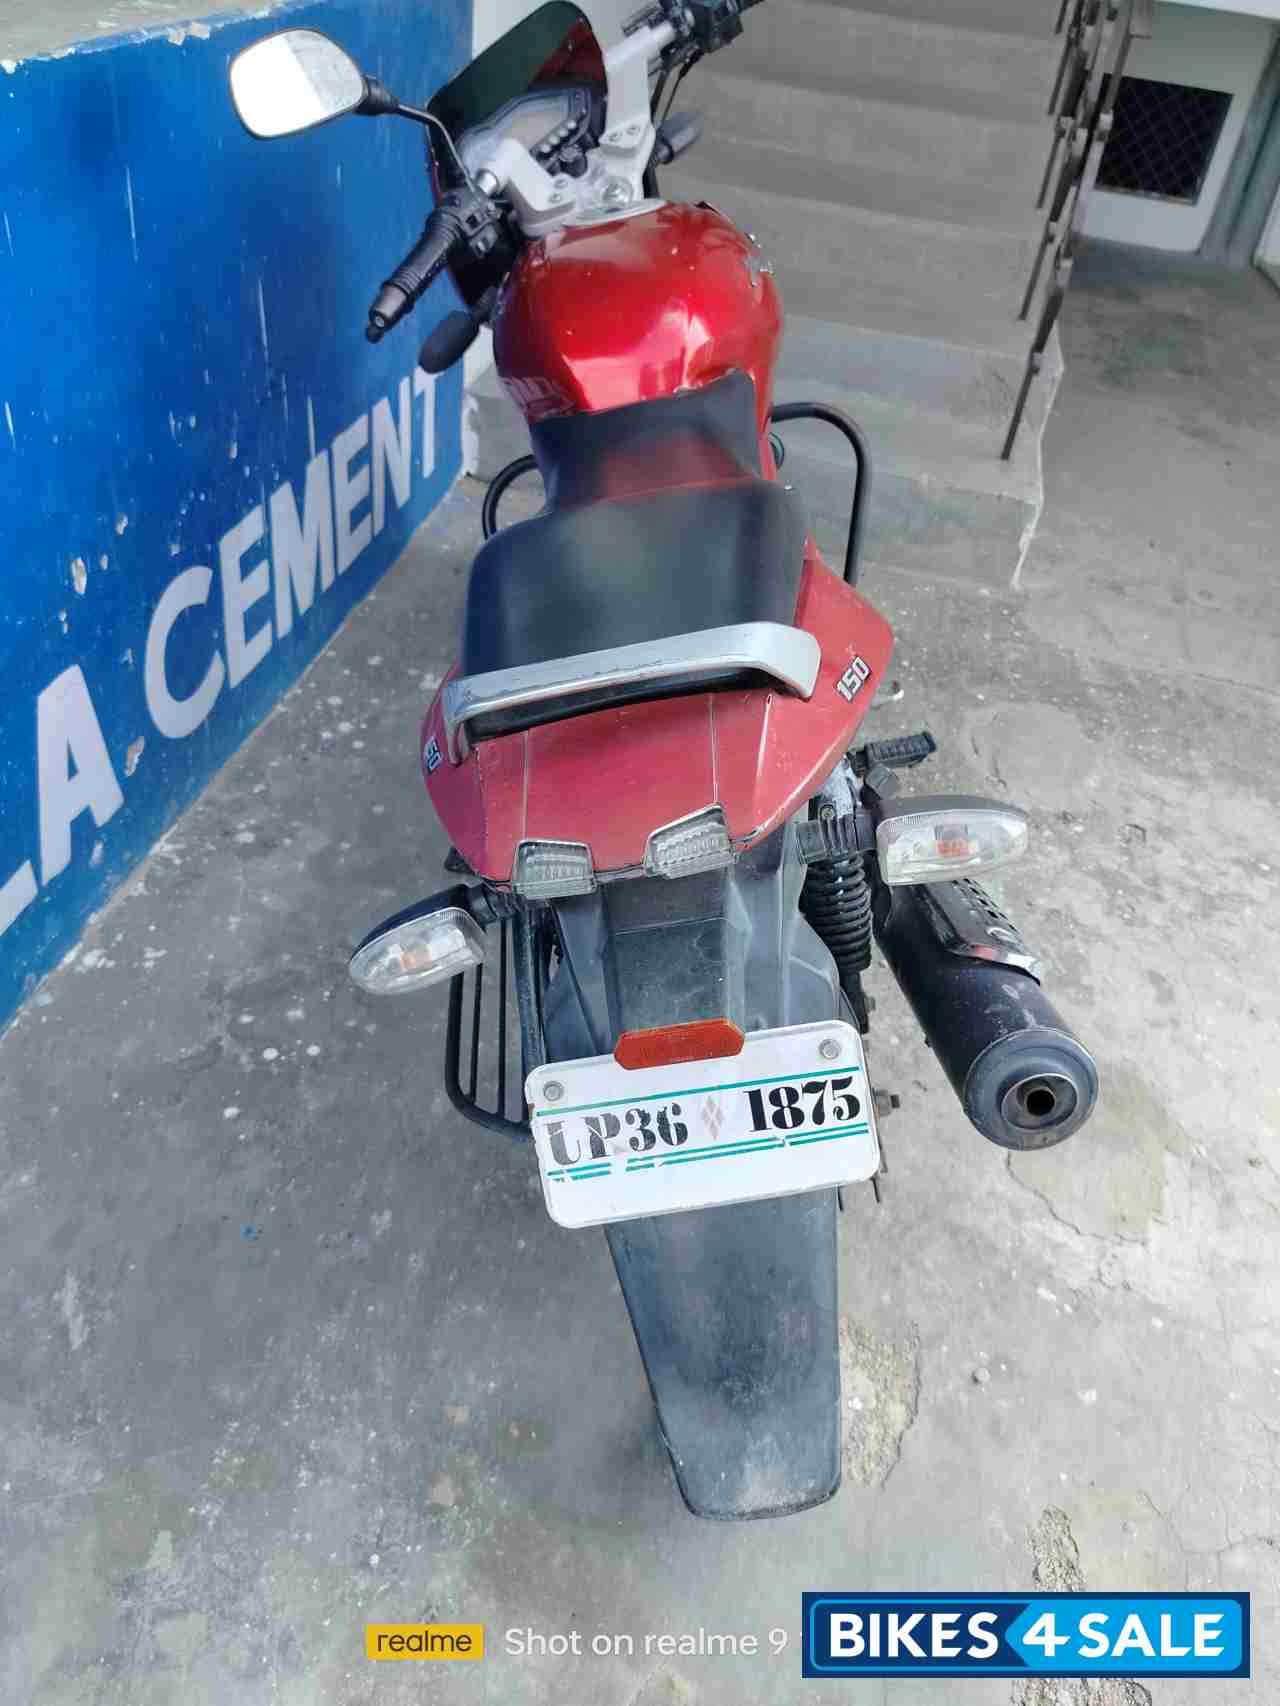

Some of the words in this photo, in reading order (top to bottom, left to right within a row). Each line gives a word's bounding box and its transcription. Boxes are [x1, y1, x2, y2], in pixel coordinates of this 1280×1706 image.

[144, 366, 445, 739] CEMENT
[836, 656, 870, 701] 150
[546, 1102, 688, 1166] UP36
[743, 1076, 861, 1133] 1875
